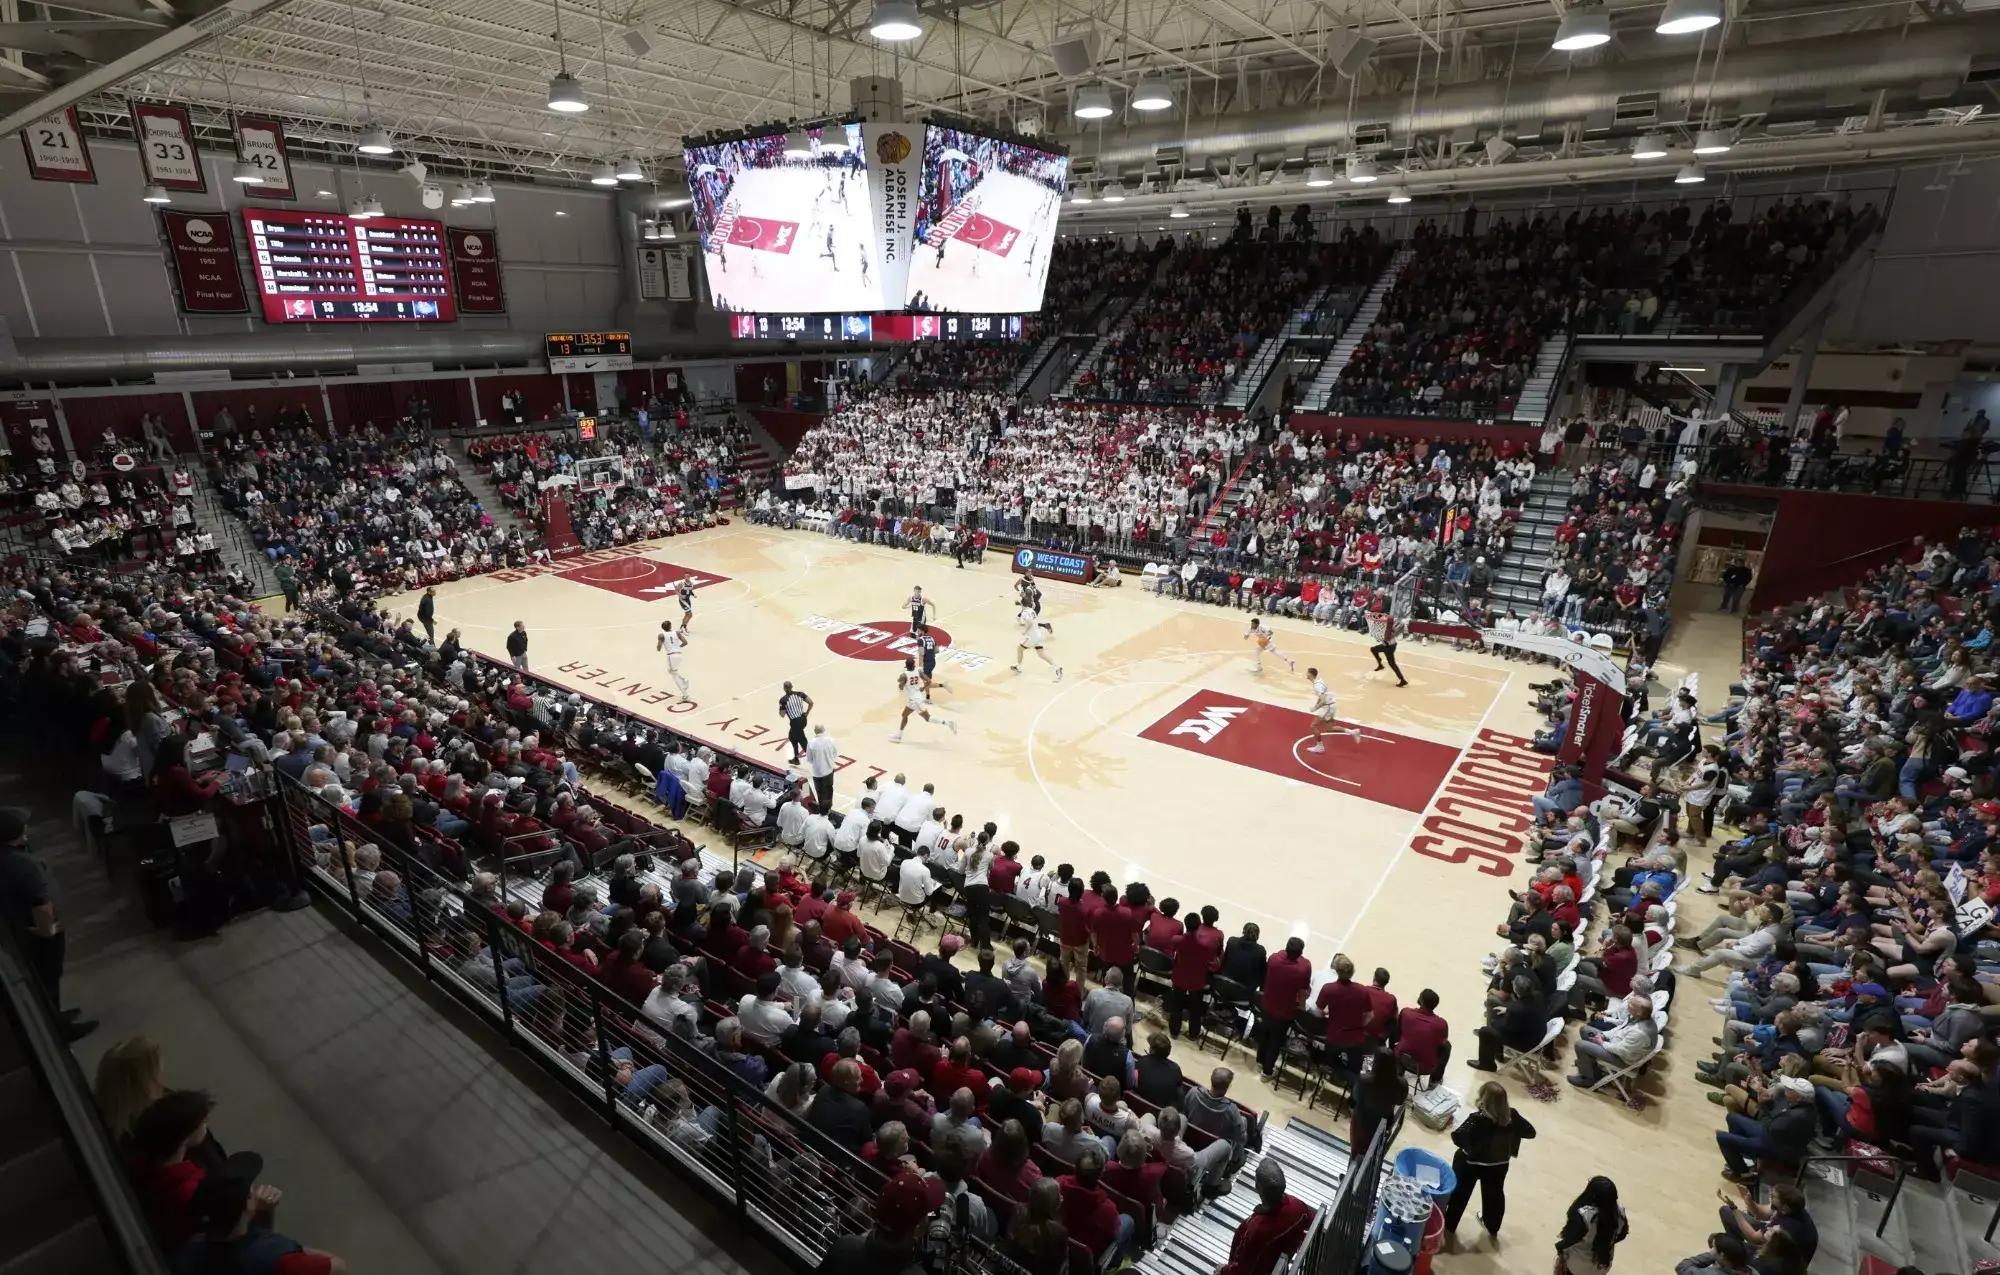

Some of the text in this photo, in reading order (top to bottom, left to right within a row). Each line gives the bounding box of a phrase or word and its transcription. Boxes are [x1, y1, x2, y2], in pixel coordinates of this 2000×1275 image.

[40, 130, 69, 148] 21
[246, 141, 274, 150] BRUNO
[153, 143, 185, 160] 33
[248, 153, 278, 170] 42
[897, 168, 906, 219] JOSEPH
[885, 168, 895, 264] ALBANESE INC.
[190, 230, 213, 238] NCAA
[897, 224, 906, 234] J.
[322, 302, 334, 313] 13
[352, 302, 379, 313] 13:54
[397, 303, 404, 312] 8
[759, 318, 768, 332] 13
[781, 317, 805, 331] 13:54
[824, 318, 831, 333] 8
[947, 318, 958, 333] 13
[971, 318, 991, 331] 13:54
[581, 333, 602, 344] 13:53
[561, 343, 570, 354] 13
[1037, 553, 1085, 568] WEST COAST
[1035, 563, 1083, 575] sports institute
[1483, 630, 1514, 640] SPALDING
[910, 676, 919, 685] 22
[1574, 683, 1596, 747] TicketSmarter
[557, 660, 888, 784] LEVEY CENTER
[1410, 728, 1557, 877] BRONCOS
[938, 837, 949, 850] 10
[1023, 877, 1032, 889] 4
[1092, 1112, 1115, 1130] NASH
